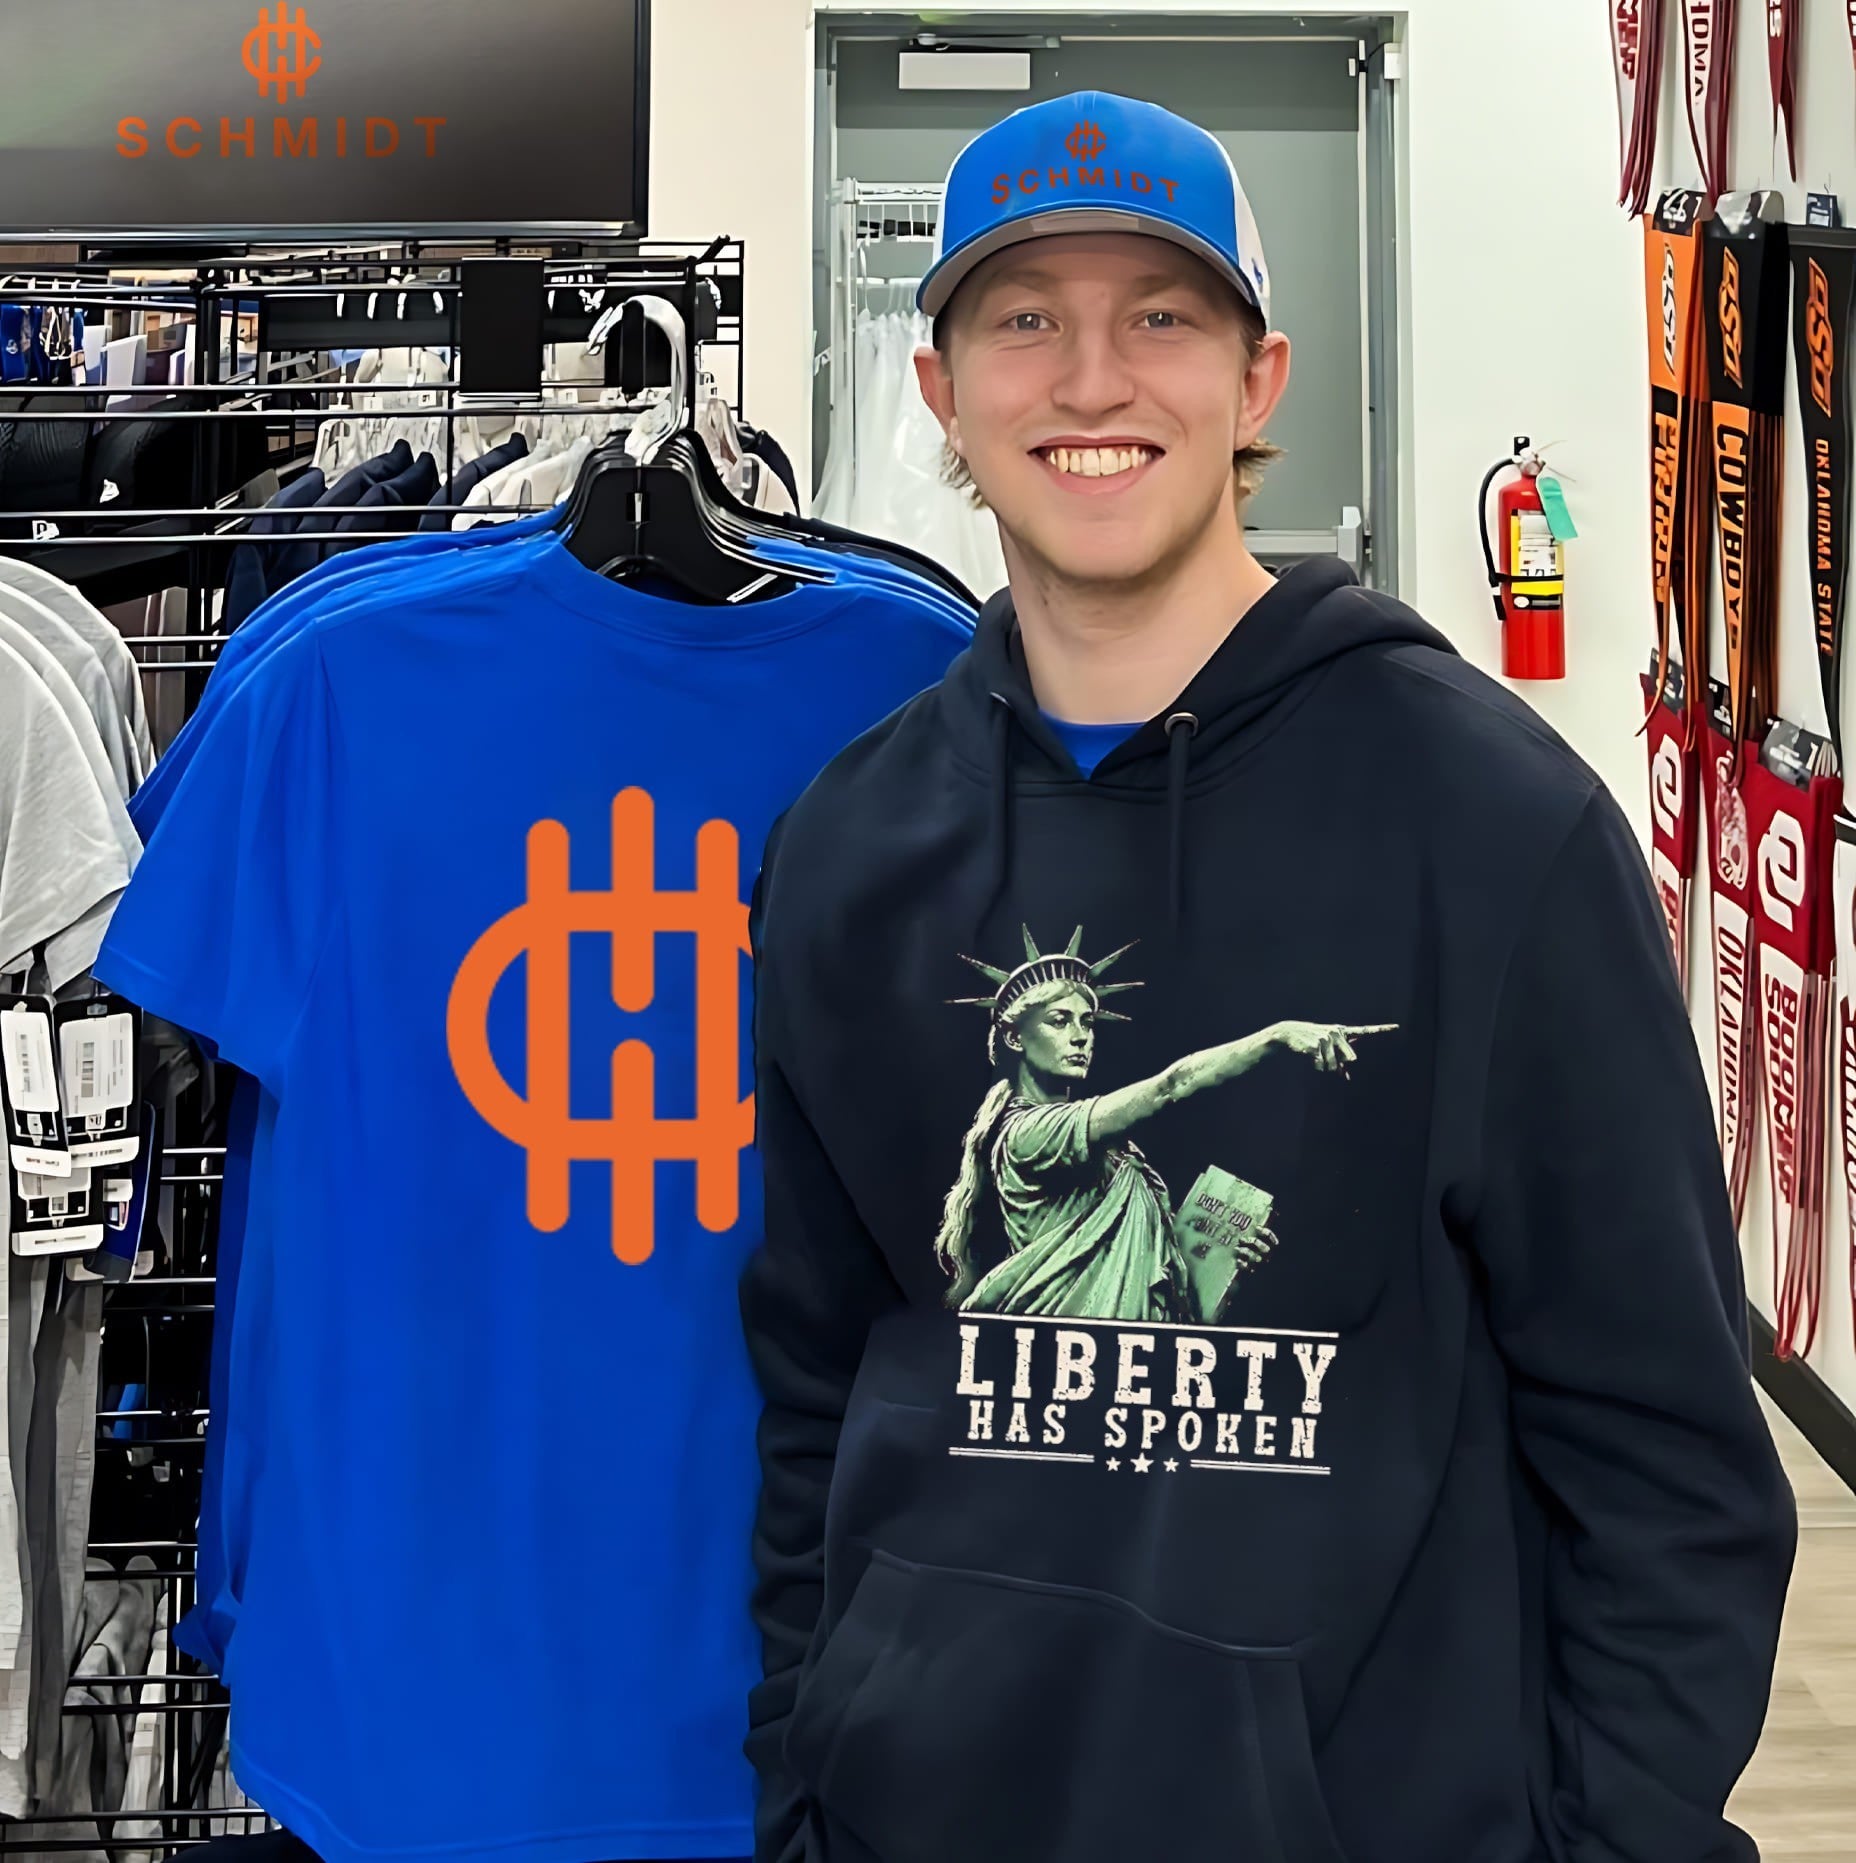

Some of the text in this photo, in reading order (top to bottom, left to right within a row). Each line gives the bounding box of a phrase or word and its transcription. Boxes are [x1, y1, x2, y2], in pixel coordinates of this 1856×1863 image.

[116, 116, 447, 159] SCHMIDT
[991, 166, 1179, 205] SCHMIDT
[956, 1325, 1338, 1414] LIBERTY
[968, 1400, 1318, 1459] HAS SPOKEN
